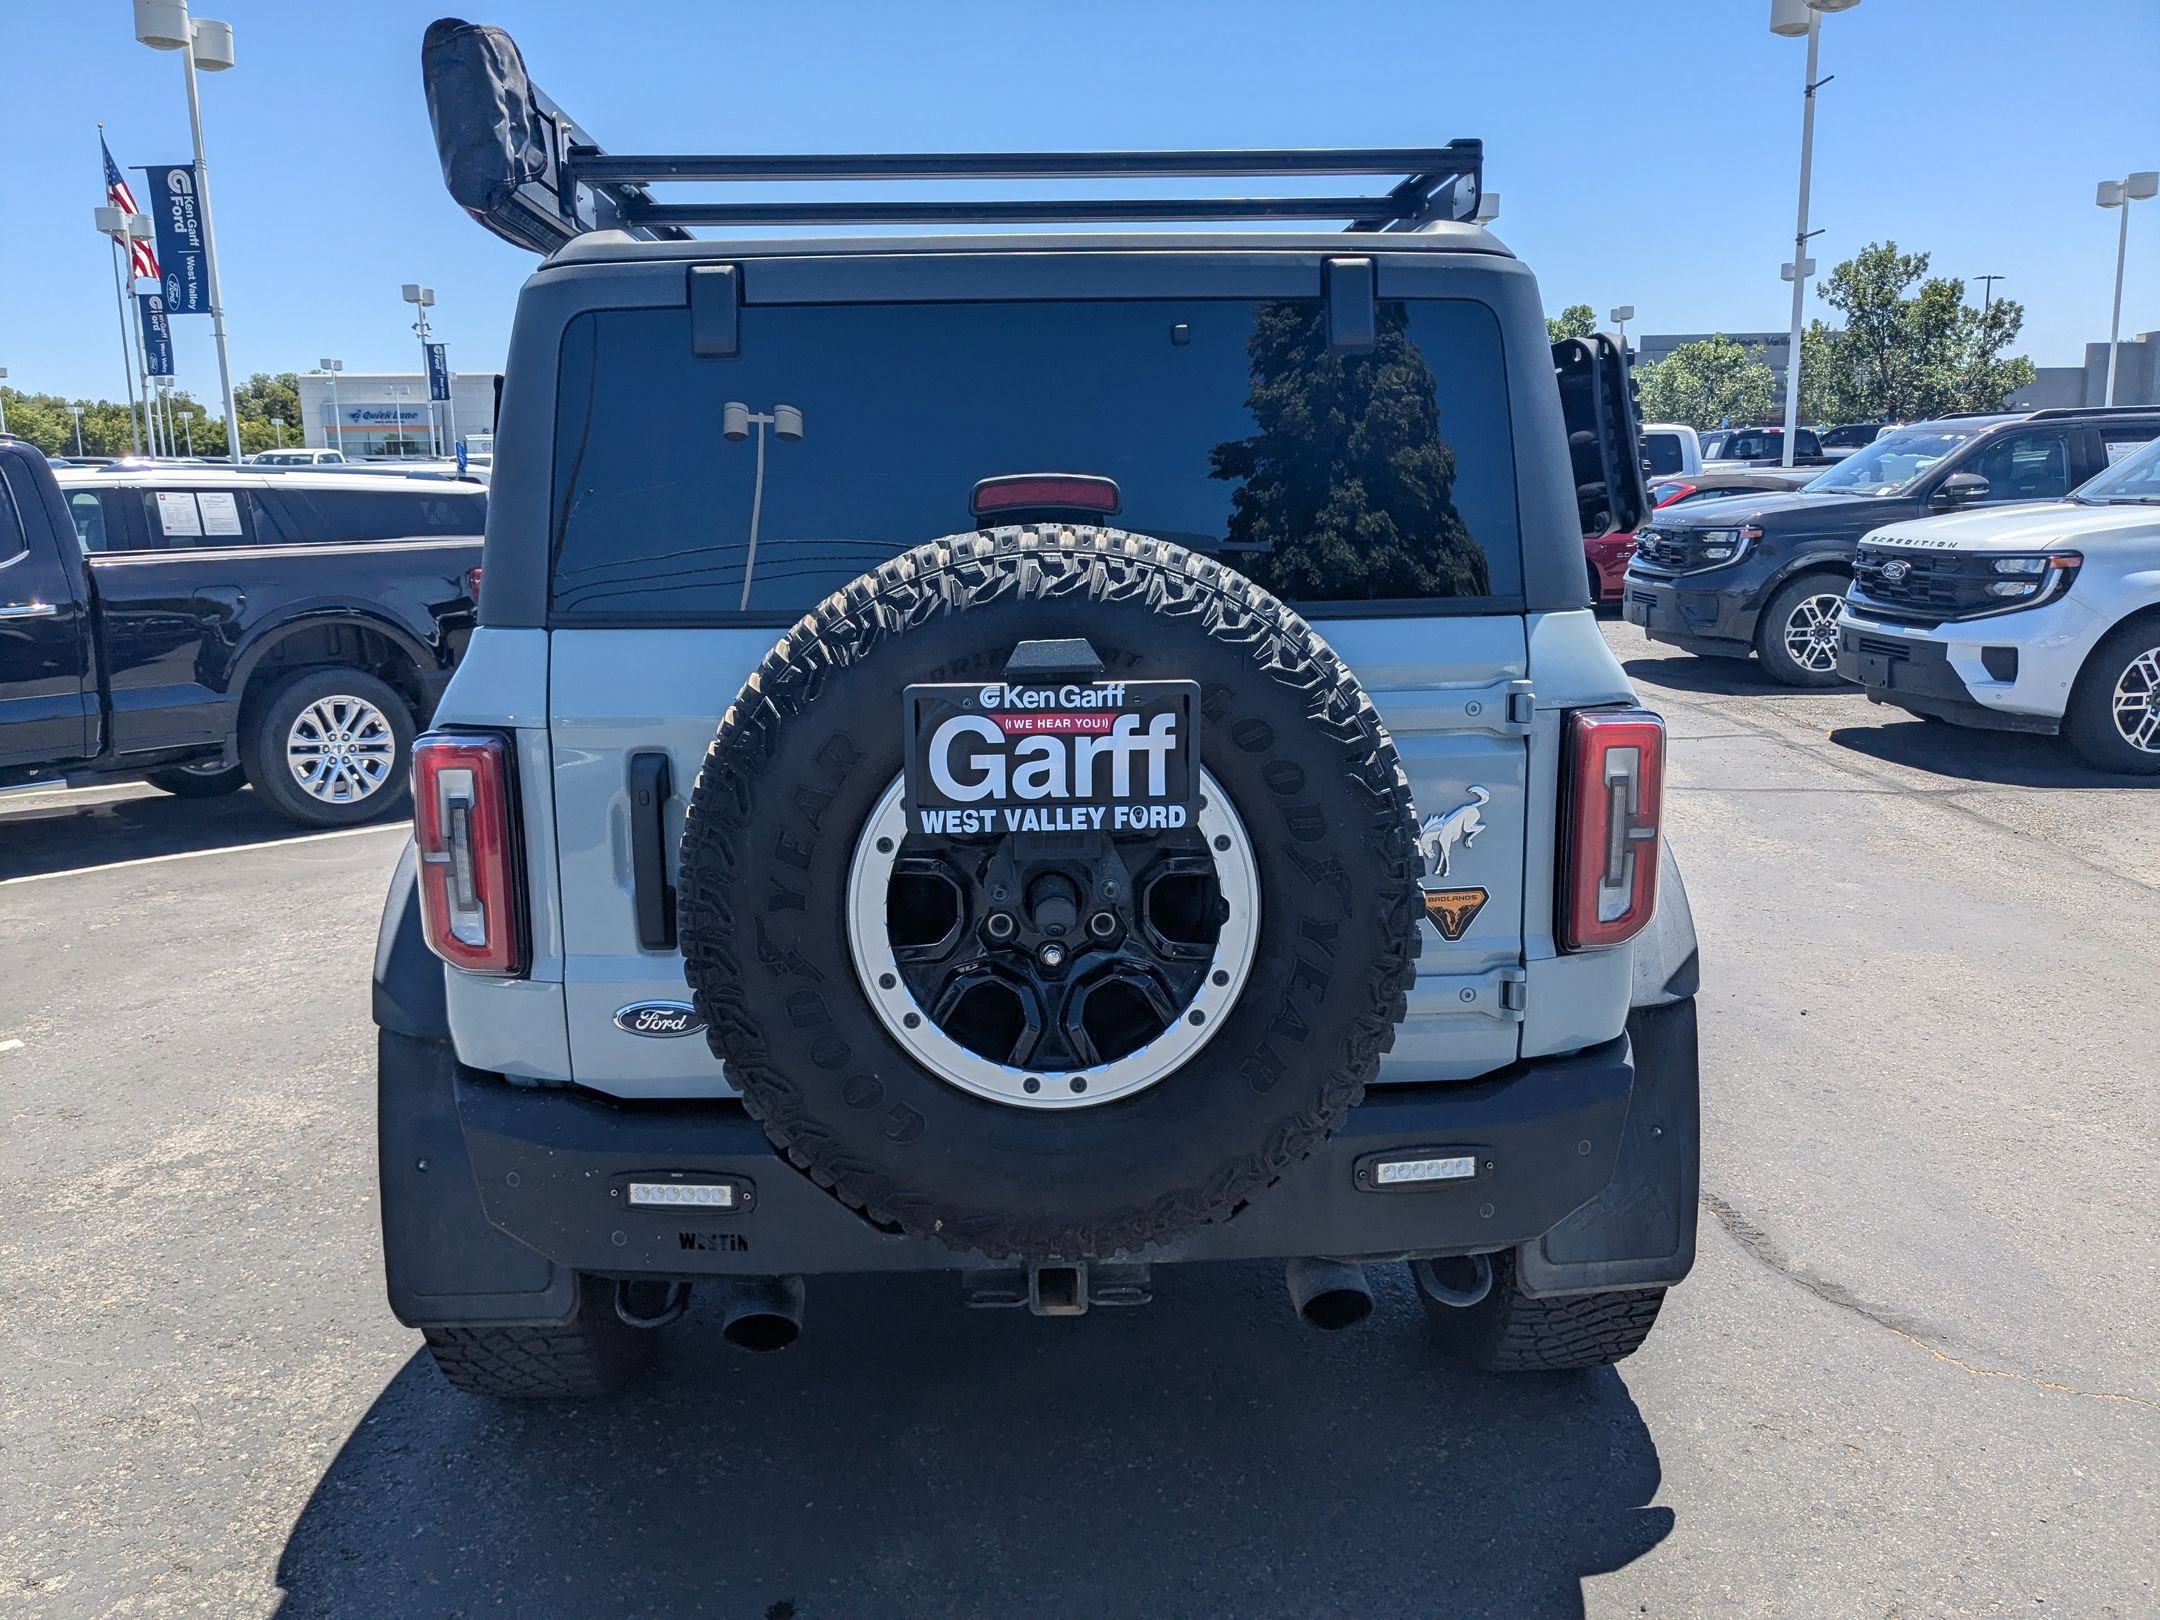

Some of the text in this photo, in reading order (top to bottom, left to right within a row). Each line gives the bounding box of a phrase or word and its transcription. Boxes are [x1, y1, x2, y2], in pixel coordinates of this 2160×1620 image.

[170, 196, 187, 233] Ford
[184, 196, 200, 311] Ken Garff West Valley
[168, 279, 179, 304] Ford
[362, 410, 418, 420] Quick Lane
[1871, 536, 1958, 548] EXPEDITION
[1003, 683, 1126, 709] Ken Garff
[1014, 718, 1101, 729] WE HEAR YOU
[928, 712, 1177, 802] Garff
[920, 804, 1187, 834] WEST VALLEY FORD
[1427, 894, 1478, 903] BADLANDS
[635, 1009, 688, 1031] Ford
